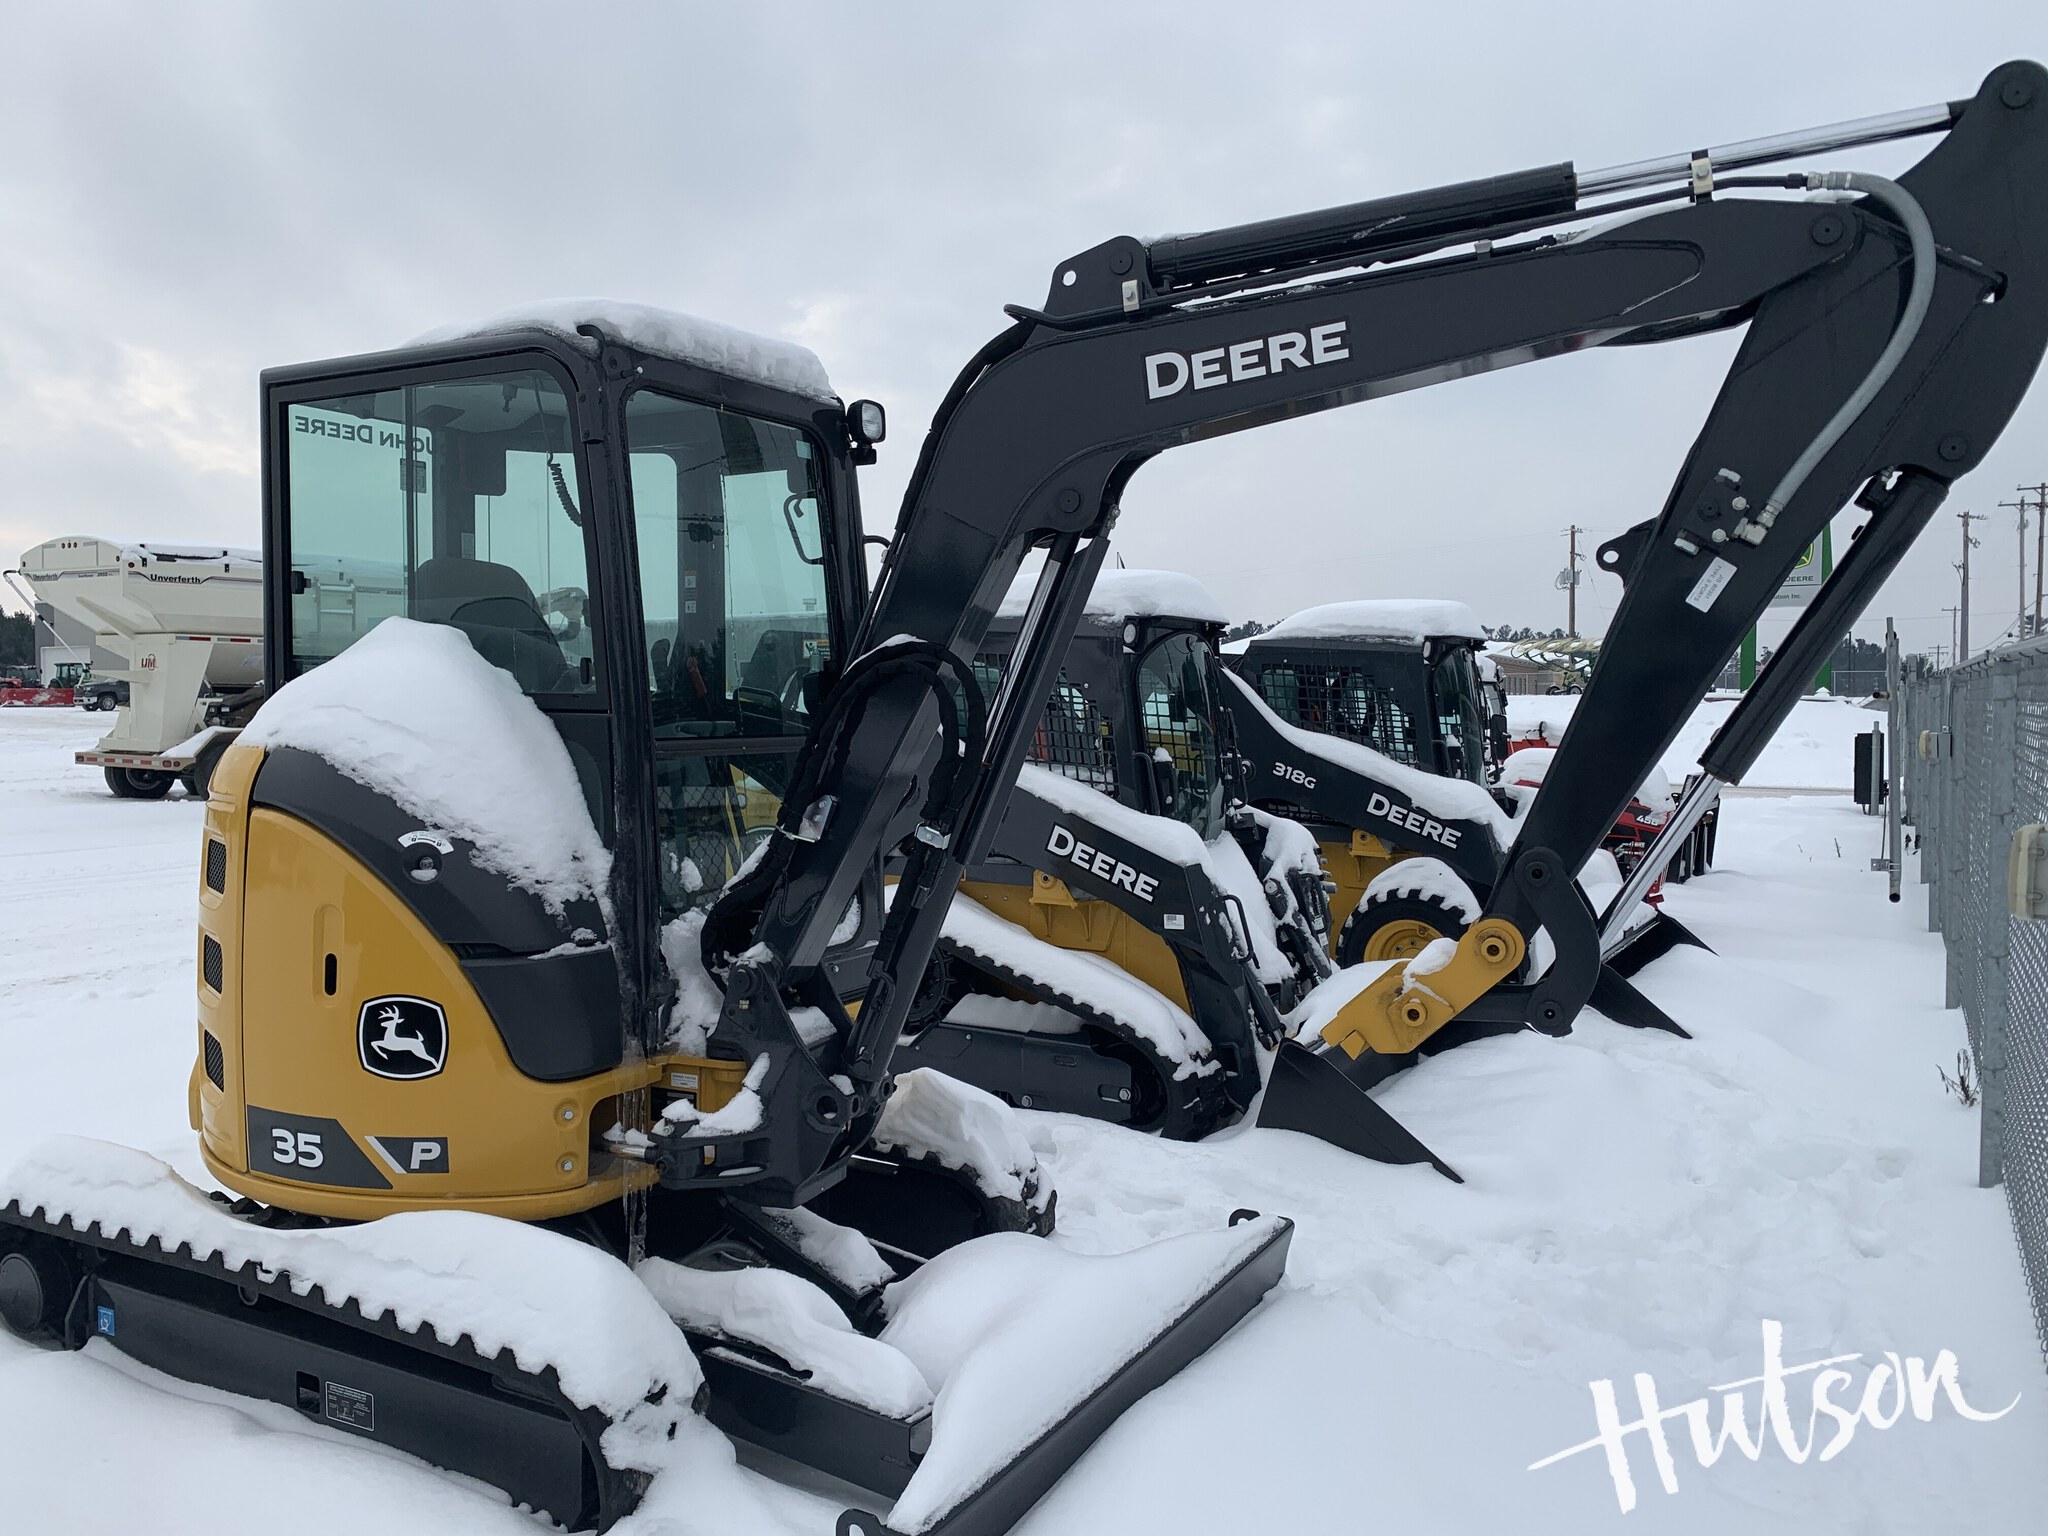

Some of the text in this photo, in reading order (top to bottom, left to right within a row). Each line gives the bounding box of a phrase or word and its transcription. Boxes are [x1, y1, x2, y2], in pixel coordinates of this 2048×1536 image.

[1145, 321, 1350, 400] DEERE
[150, 573, 201, 584] Unverferth
[1272, 762, 1317, 790] 318G
[1366, 792, 1462, 849] DEERE
[1047, 825, 1159, 902] DEERE
[272, 1128, 441, 1169] 35 P
